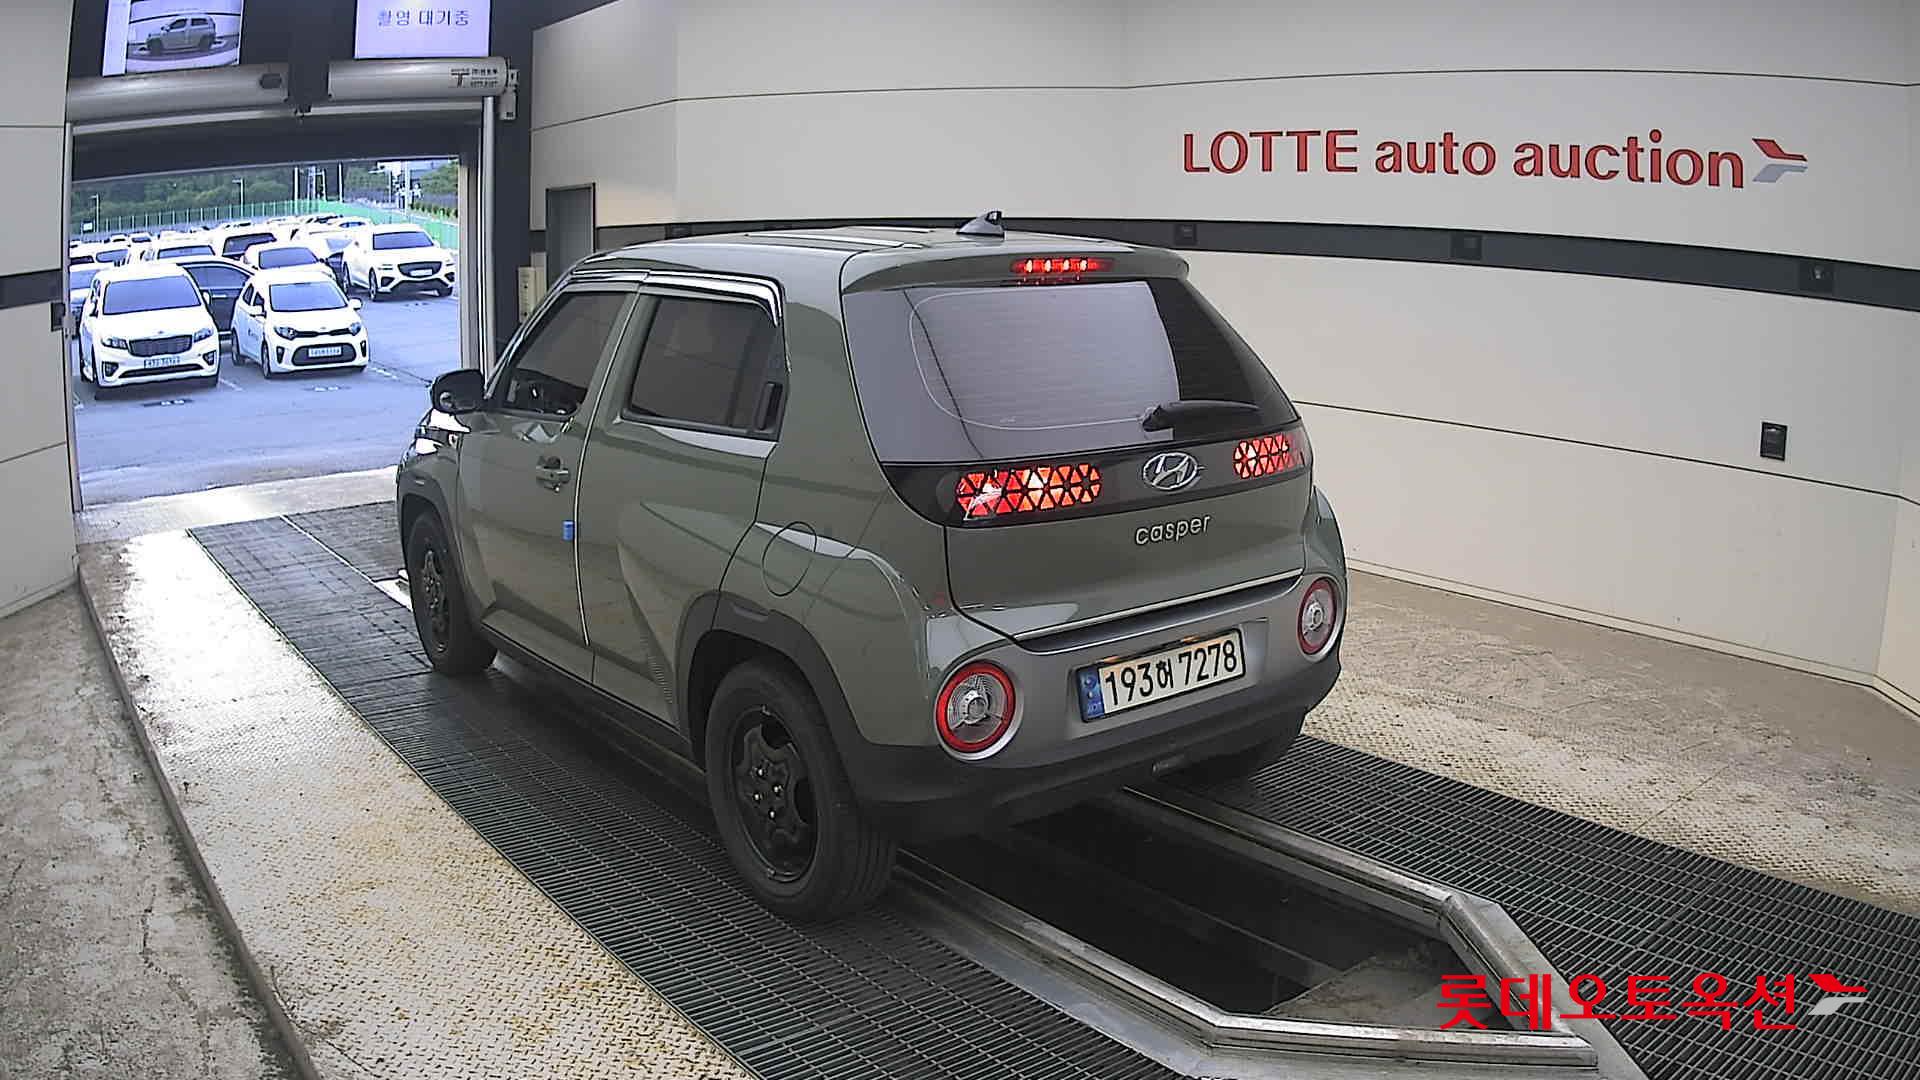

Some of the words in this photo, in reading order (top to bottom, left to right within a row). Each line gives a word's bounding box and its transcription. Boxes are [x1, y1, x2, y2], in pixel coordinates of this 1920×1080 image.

[419, 9, 469, 26] 대기중
[1183, 129, 1358, 174] LOTTE
[1375, 133, 1496, 175] auto
[1513, 129, 1744, 188] auction
[1135, 515, 1211, 545] casper
[1105, 657, 1174, 706] 193허
[1178, 640, 1238, 686] 7278
